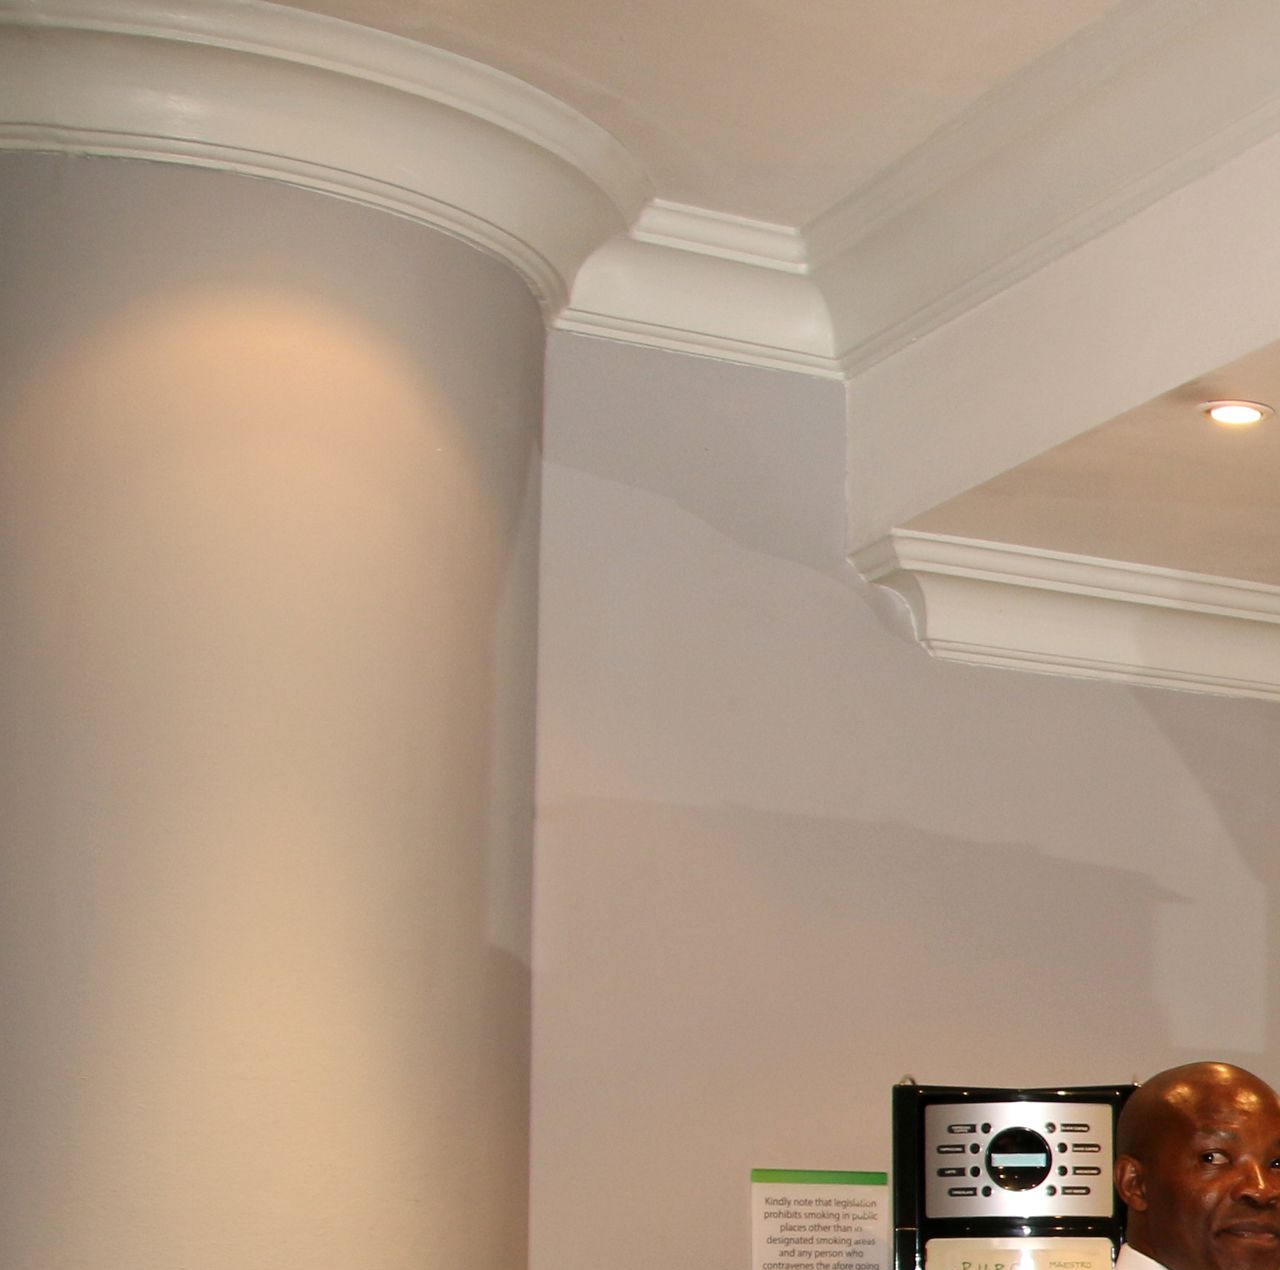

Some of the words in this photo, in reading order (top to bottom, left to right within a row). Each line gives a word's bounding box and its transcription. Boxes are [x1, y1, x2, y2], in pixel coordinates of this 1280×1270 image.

[765, 1197, 791, 1208] Kindly
[794, 1199, 813, 1207] note
[815, 1198, 832, 1207] that
[834, 1198, 877, 1209] legislation
[764, 1211, 802, 1219] prohibits
[804, 1211, 840, 1220] smoking
[852, 1213, 878, 1221] public
[780, 1223, 806, 1233] places
[808, 1224, 831, 1232] other
[833, 1224, 852, 1232] than
[767, 1236, 814, 1246] designated
[816, 1237, 852, 1246] smoking
[779, 1249, 795, 1257] and
[797, 1250, 812, 1258] any
[815, 1250, 843, 1258] person
[845, 1249, 864, 1257] who
[762, 1262, 814, 1270] contravenes
[816, 1262, 830, 1270] the
[832, 1262, 853, 1270] afore
[1049, 1261, 1092, 1269] MAESTRO
